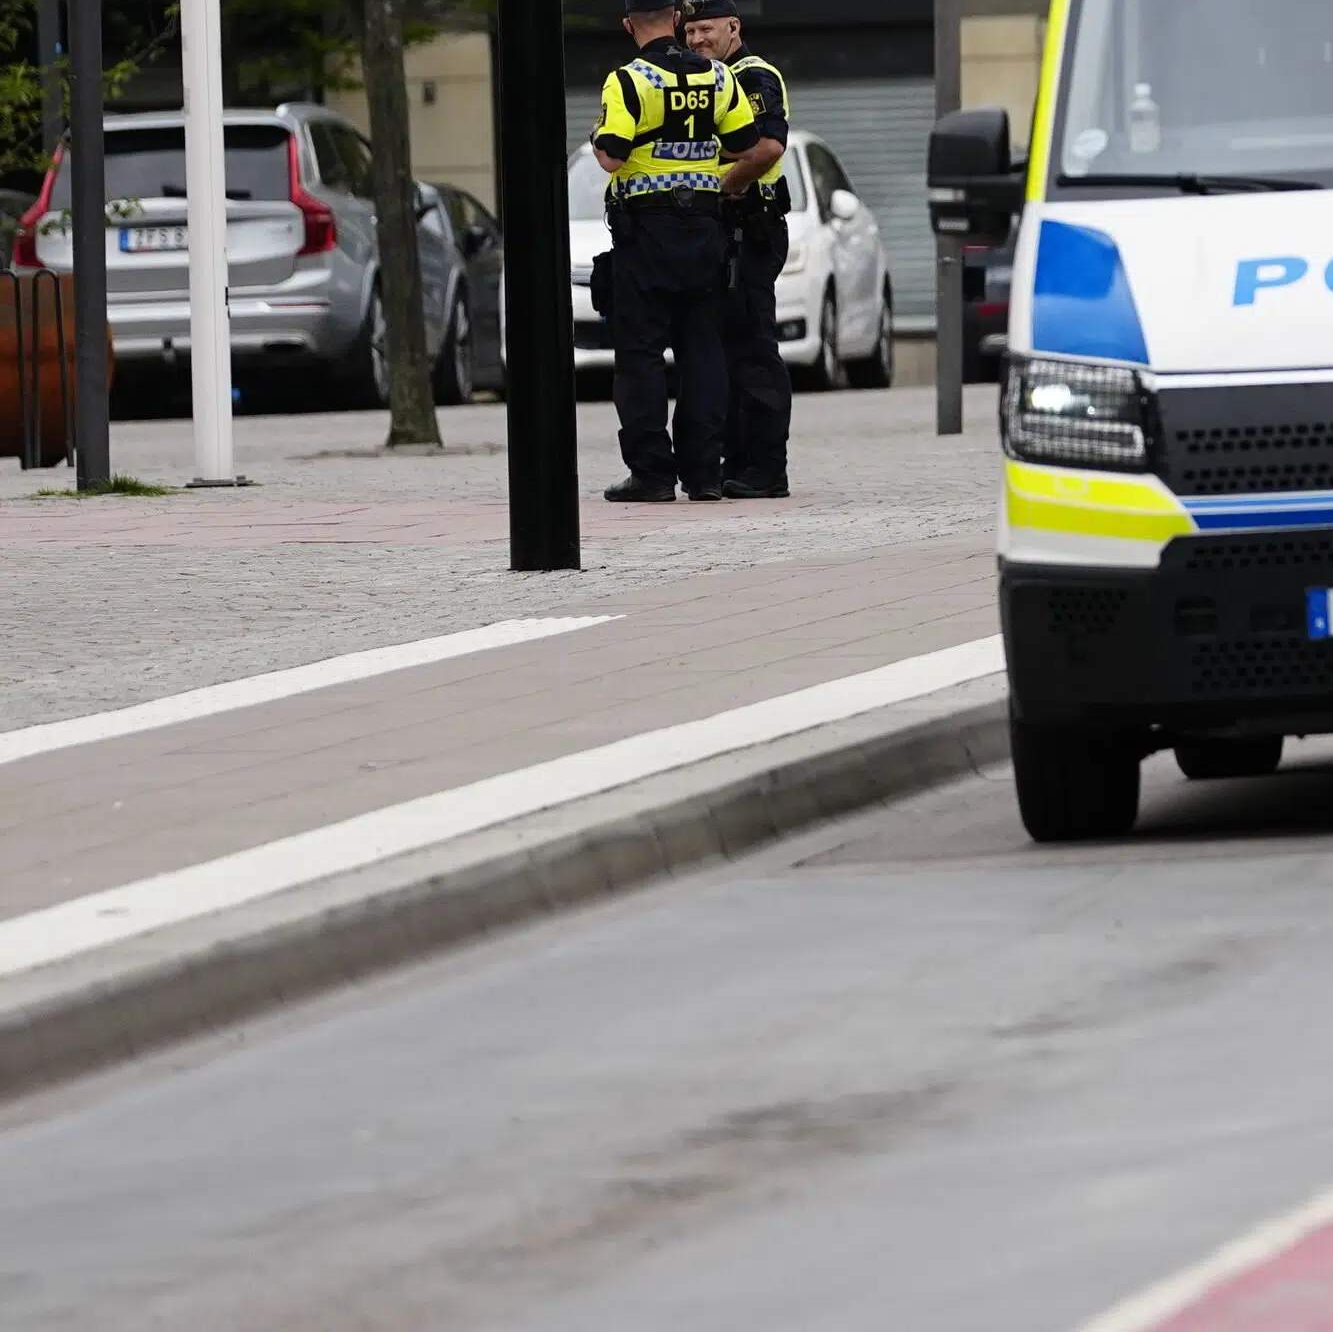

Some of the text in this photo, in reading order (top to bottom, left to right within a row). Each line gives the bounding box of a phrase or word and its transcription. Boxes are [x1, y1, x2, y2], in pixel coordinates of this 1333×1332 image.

[670, 89, 709, 111] D65
[684, 114, 695, 139] 1
[654, 141, 717, 158] POLIS
